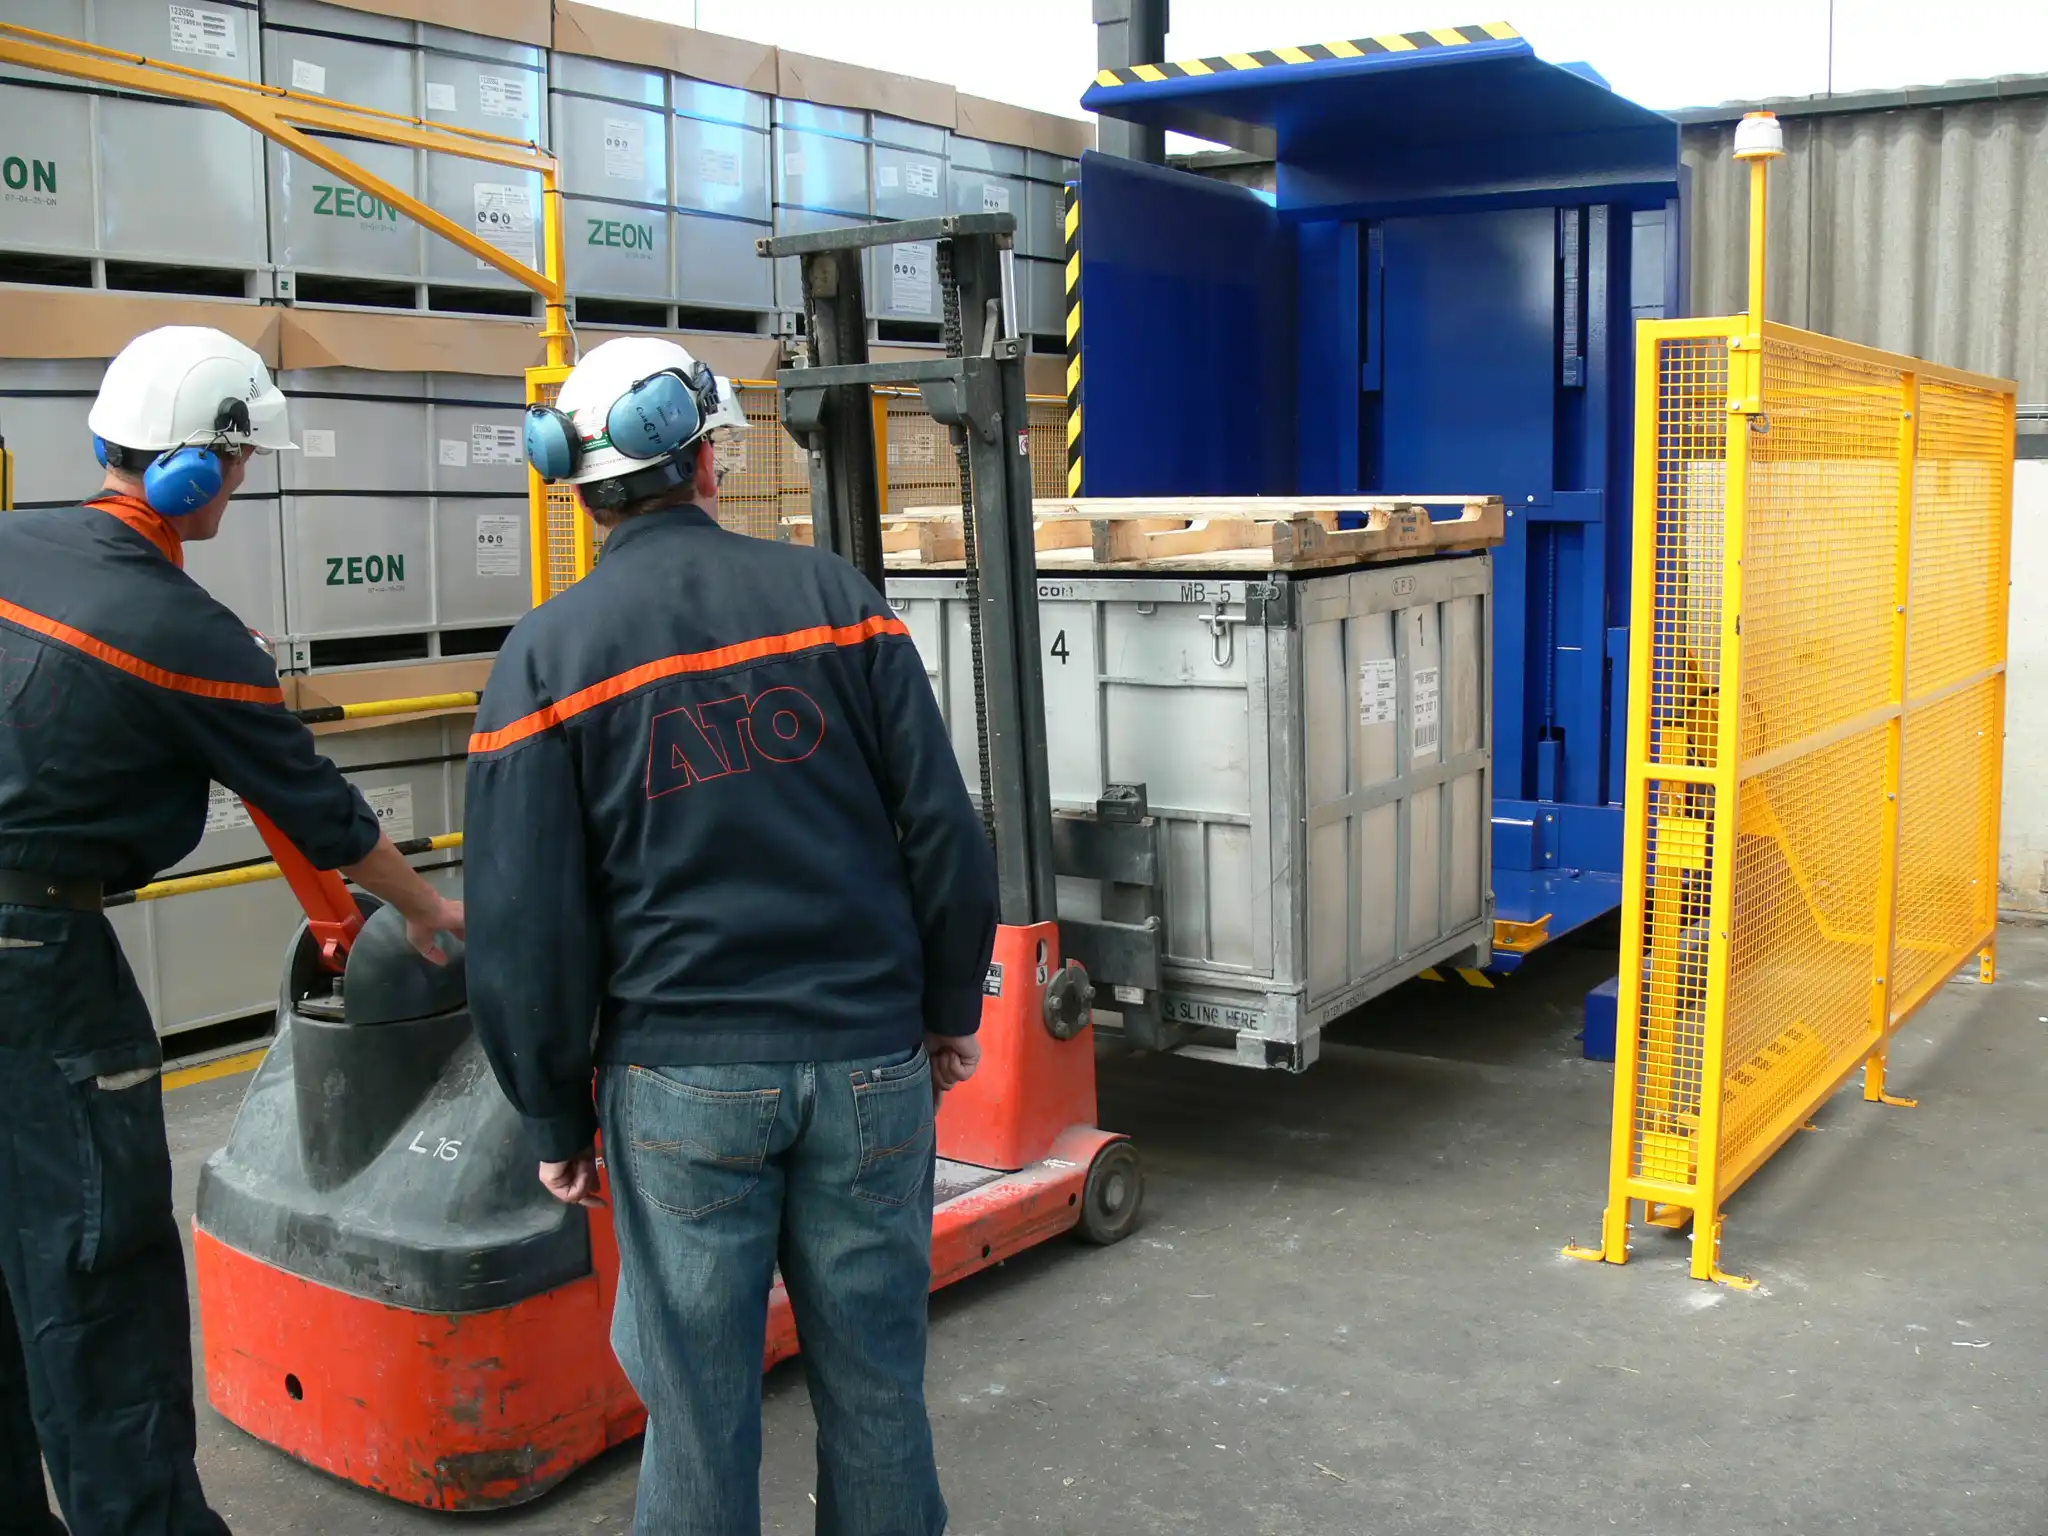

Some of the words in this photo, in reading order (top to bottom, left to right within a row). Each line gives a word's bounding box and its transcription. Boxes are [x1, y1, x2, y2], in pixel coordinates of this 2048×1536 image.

[312, 185, 397, 222] ZEON
[587, 219, 653, 251] ZEON
[326, 554, 405, 586] ZEON
[1181, 582, 1231, 603] MB-5
[1417, 612, 1424, 647] 1
[1050, 629, 1070, 665] 4
[646, 685, 826, 801] ATO
[1180, 1002, 1219, 1024] SLING
[1225, 1010, 1258, 1030] HERE
[408, 1130, 428, 1154] L
[433, 1136, 463, 1161] 16
